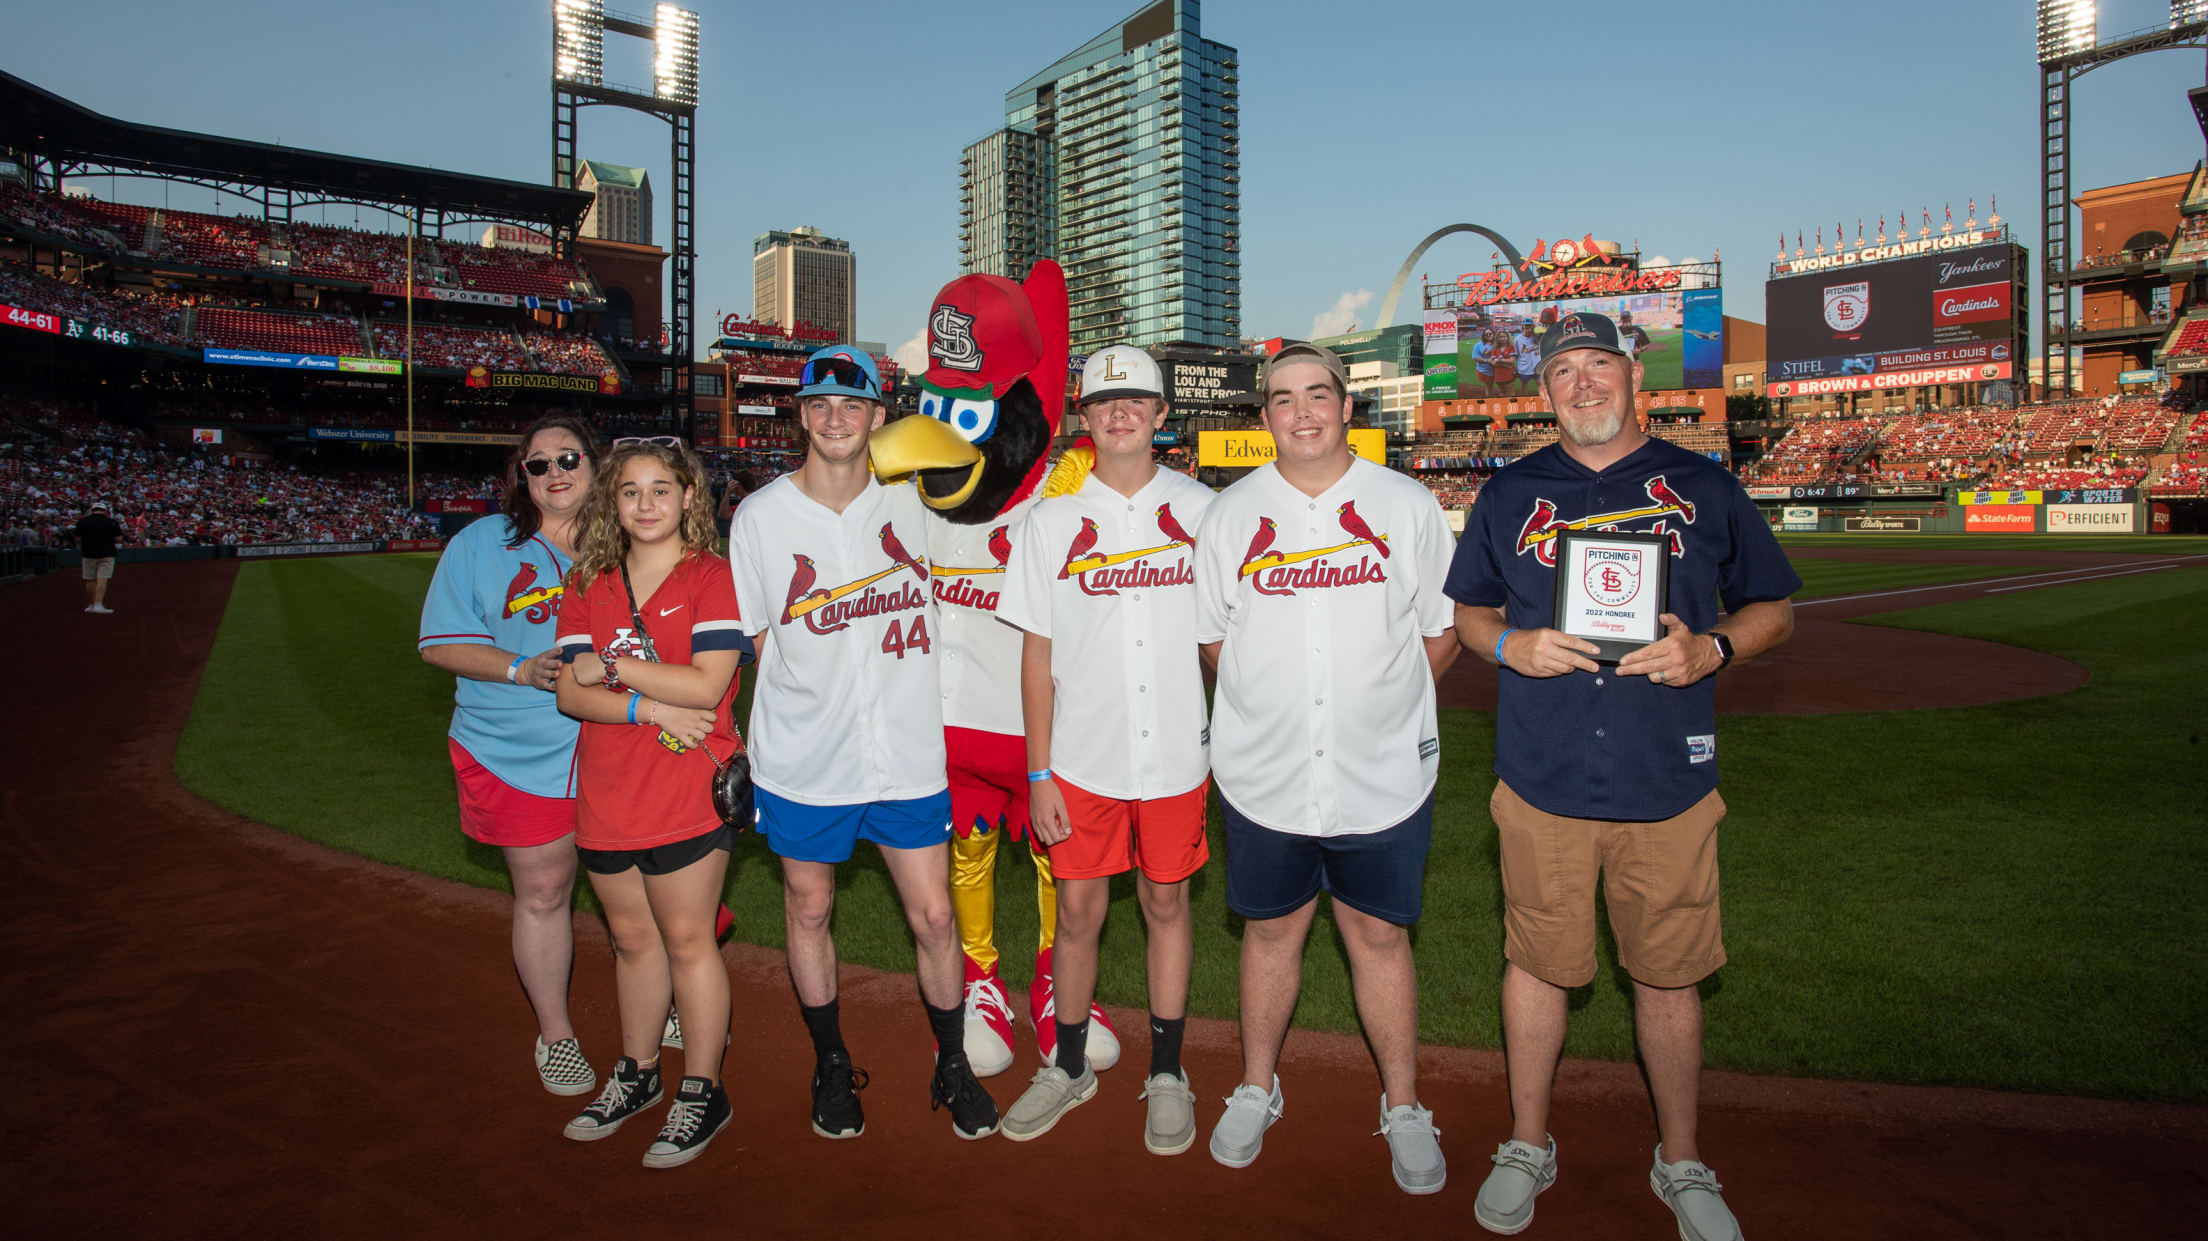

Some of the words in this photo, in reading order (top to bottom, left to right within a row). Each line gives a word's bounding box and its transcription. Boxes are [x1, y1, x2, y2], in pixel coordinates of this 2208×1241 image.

[1789, 253, 1857, 274] WORLD
[1861, 231, 1984, 262] CHAMPIONS
[1938, 257, 2005, 284] Yankees
[1457, 263, 1682, 307] Budweiser
[1826, 285, 1860, 296] PITCHING
[448, 291, 501, 303] POWER
[1941, 296, 2000, 316] Cardinals
[8, 309, 52, 330] 44-61
[723, 313, 785, 337] Cardinals
[785, 320, 837, 341] Nation
[1424, 321, 1456, 331] KMOX
[92, 327, 129, 345] 41-66
[1881, 353, 1931, 366] BUILDING
[1933, 351, 1950, 361] ST.
[1952, 347, 1987, 359] LOUIS
[1104, 354, 1126, 381] L
[1175, 365, 1206, 376] FROM
[1208, 367, 1228, 378] THE
[1783, 360, 1825, 376] STIFEL
[2177, 361, 2201, 370] Mercy
[493, 373, 522, 387] BIG
[523, 375, 559, 389] MAC
[559, 377, 598, 392] LAND
[1175, 376, 1196, 386] LOU
[1198, 377, 1221, 387] AND
[1798, 378, 1858, 394] BROWN
[1861, 379, 1871, 389] &
[1874, 368, 1973, 388] CROUPPEN
[1175, 387, 1209, 398] WE'RE
[1493, 404, 1500, 414] 9
[1507, 403, 1518, 413] 10
[1525, 402, 1537, 412] 14
[1650, 396, 1666, 408] 45
[1671, 395, 1686, 407] 85
[316, 429, 348, 439] Webster
[350, 429, 390, 440] University
[1807, 487, 1825, 496] 6:47
[2082, 489, 2124, 497] SPORTS
[2050, 511, 2128, 526] PERFICIENT
[1588, 550, 1630, 561] PITCHING
[1078, 552, 1195, 596] Cardinals
[1252, 550, 1388, 596] Cardinals
[804, 580, 928, 635] Cardinals
[1605, 610, 1636, 619] HONOREE
[881, 614, 930, 659] 44
